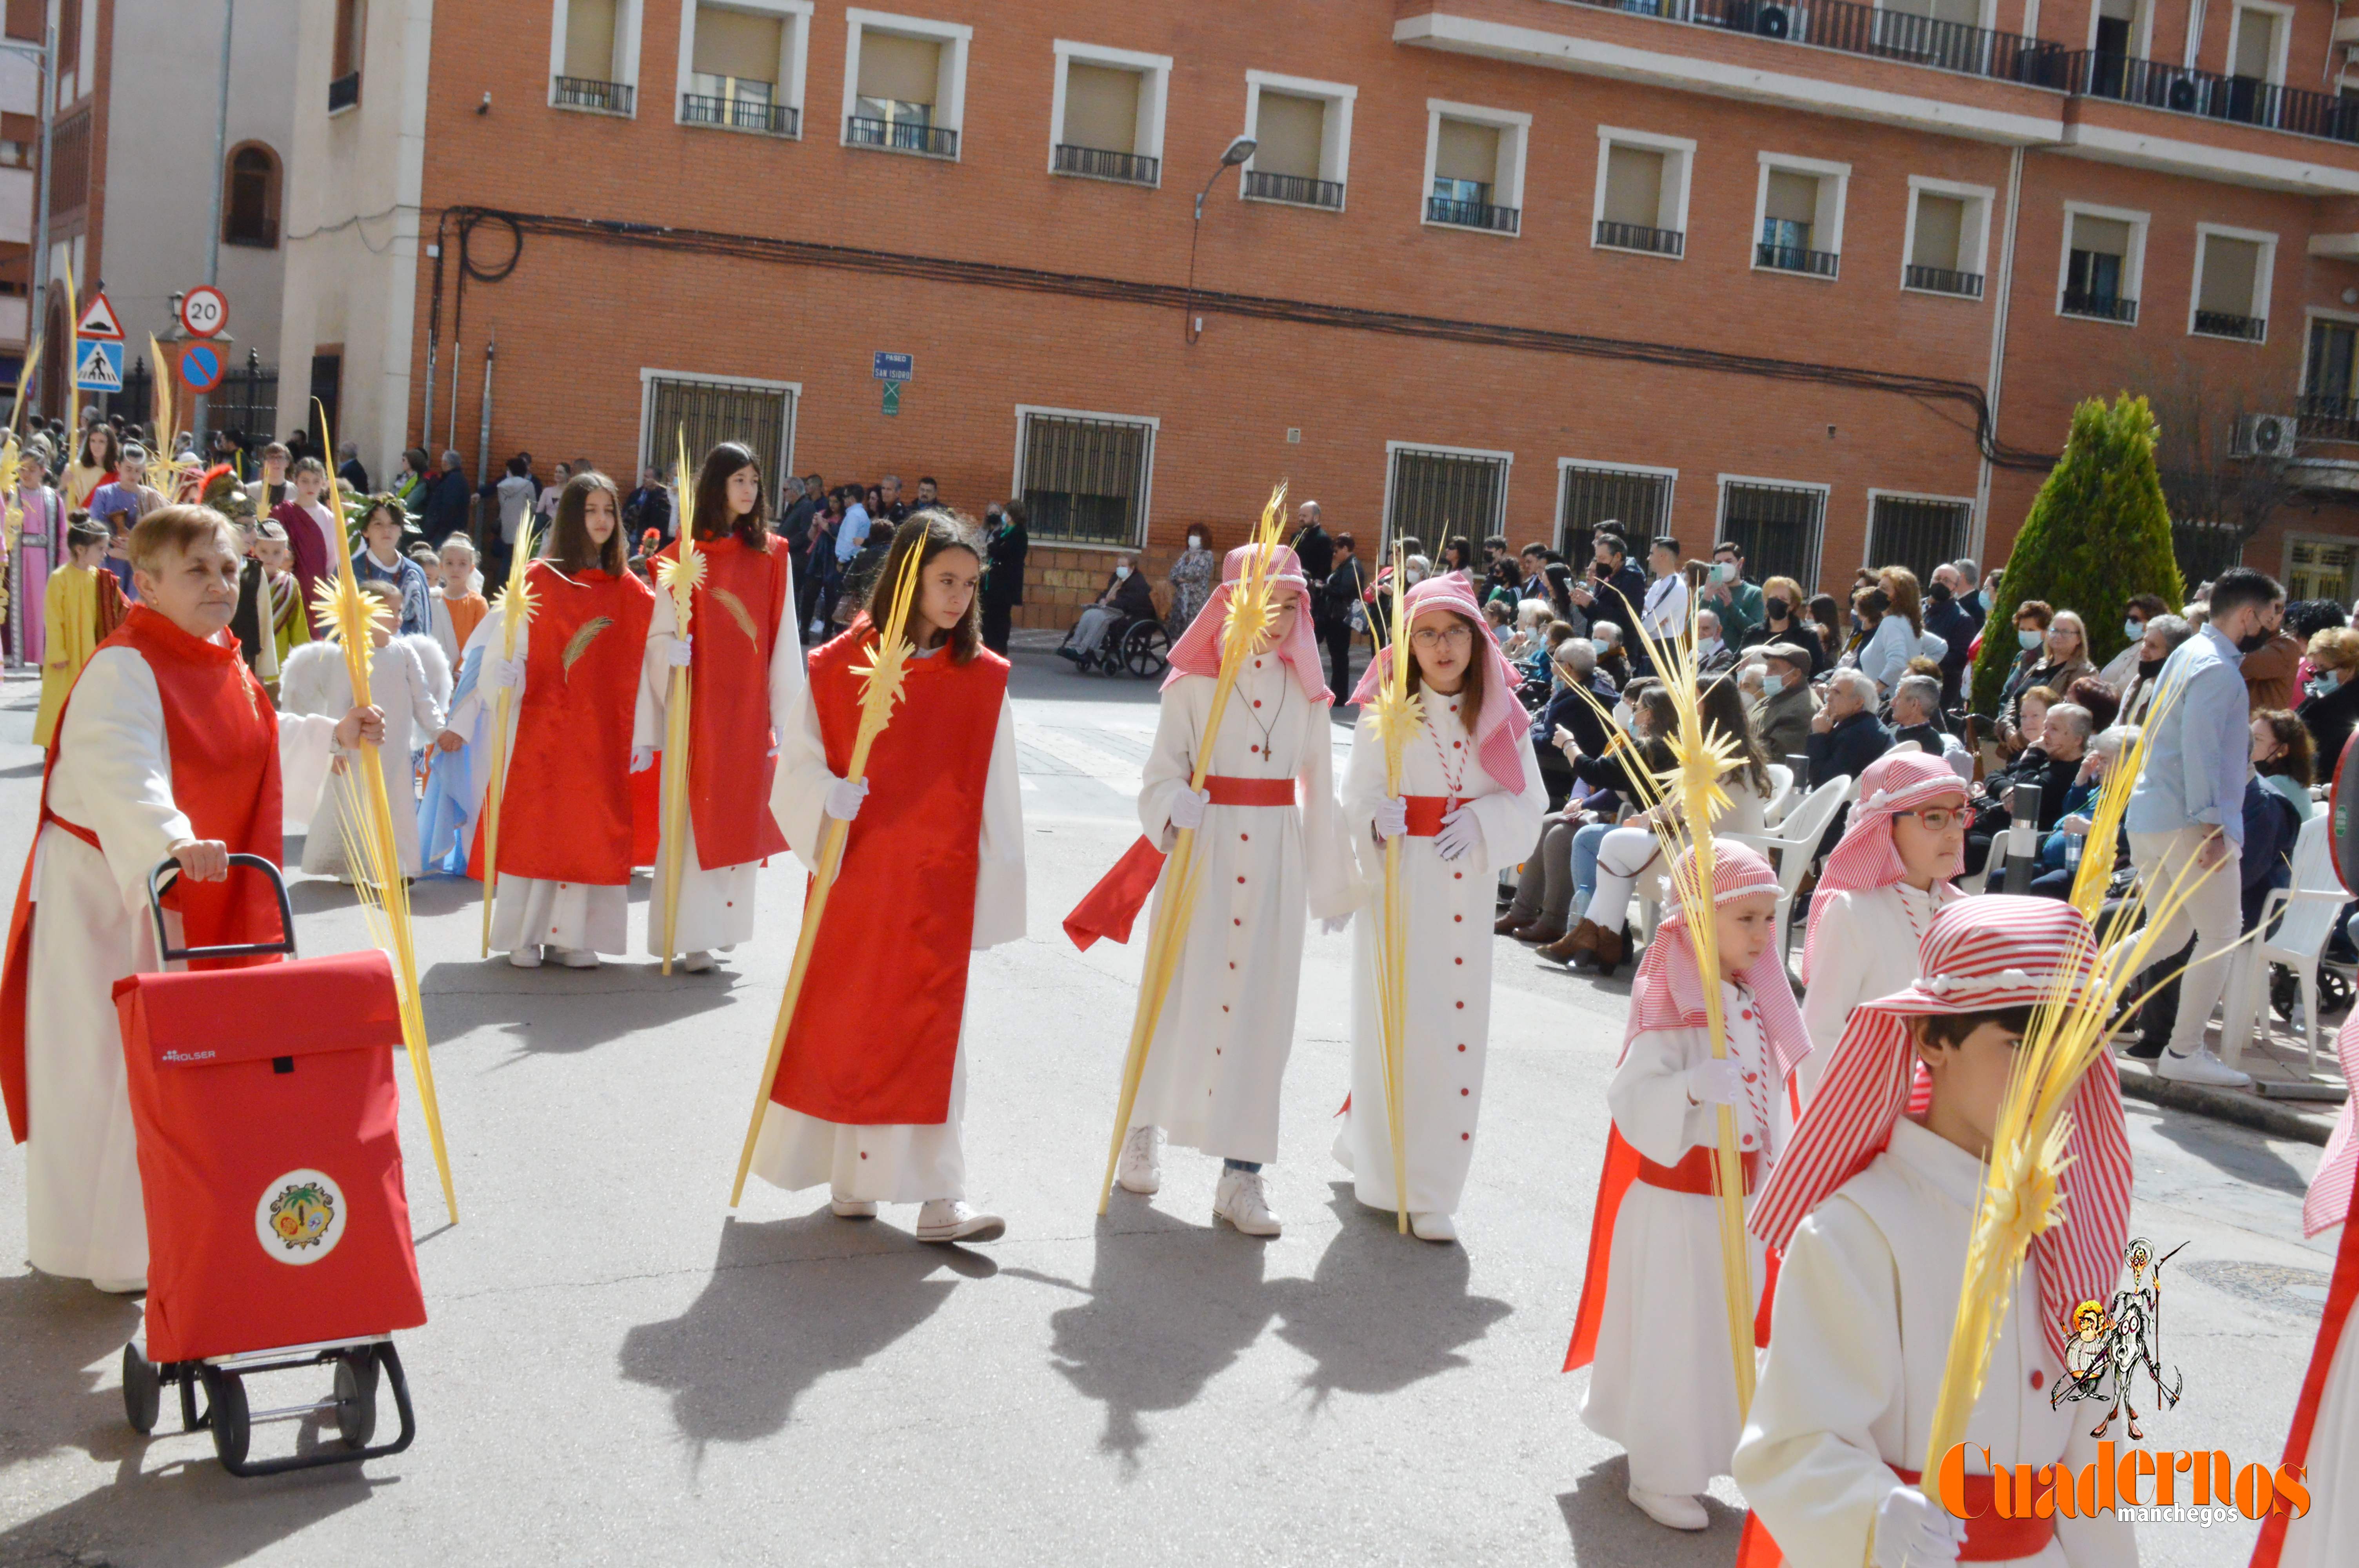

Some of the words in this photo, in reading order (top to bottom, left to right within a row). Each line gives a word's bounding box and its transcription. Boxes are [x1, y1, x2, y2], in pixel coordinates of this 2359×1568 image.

[191, 303, 216, 320] 20
[886, 354, 906, 362] PASEO
[875, 368, 887, 377] SAN
[889, 369, 910, 379] ISIDRO
[173, 1050, 216, 1062] ROLSER
